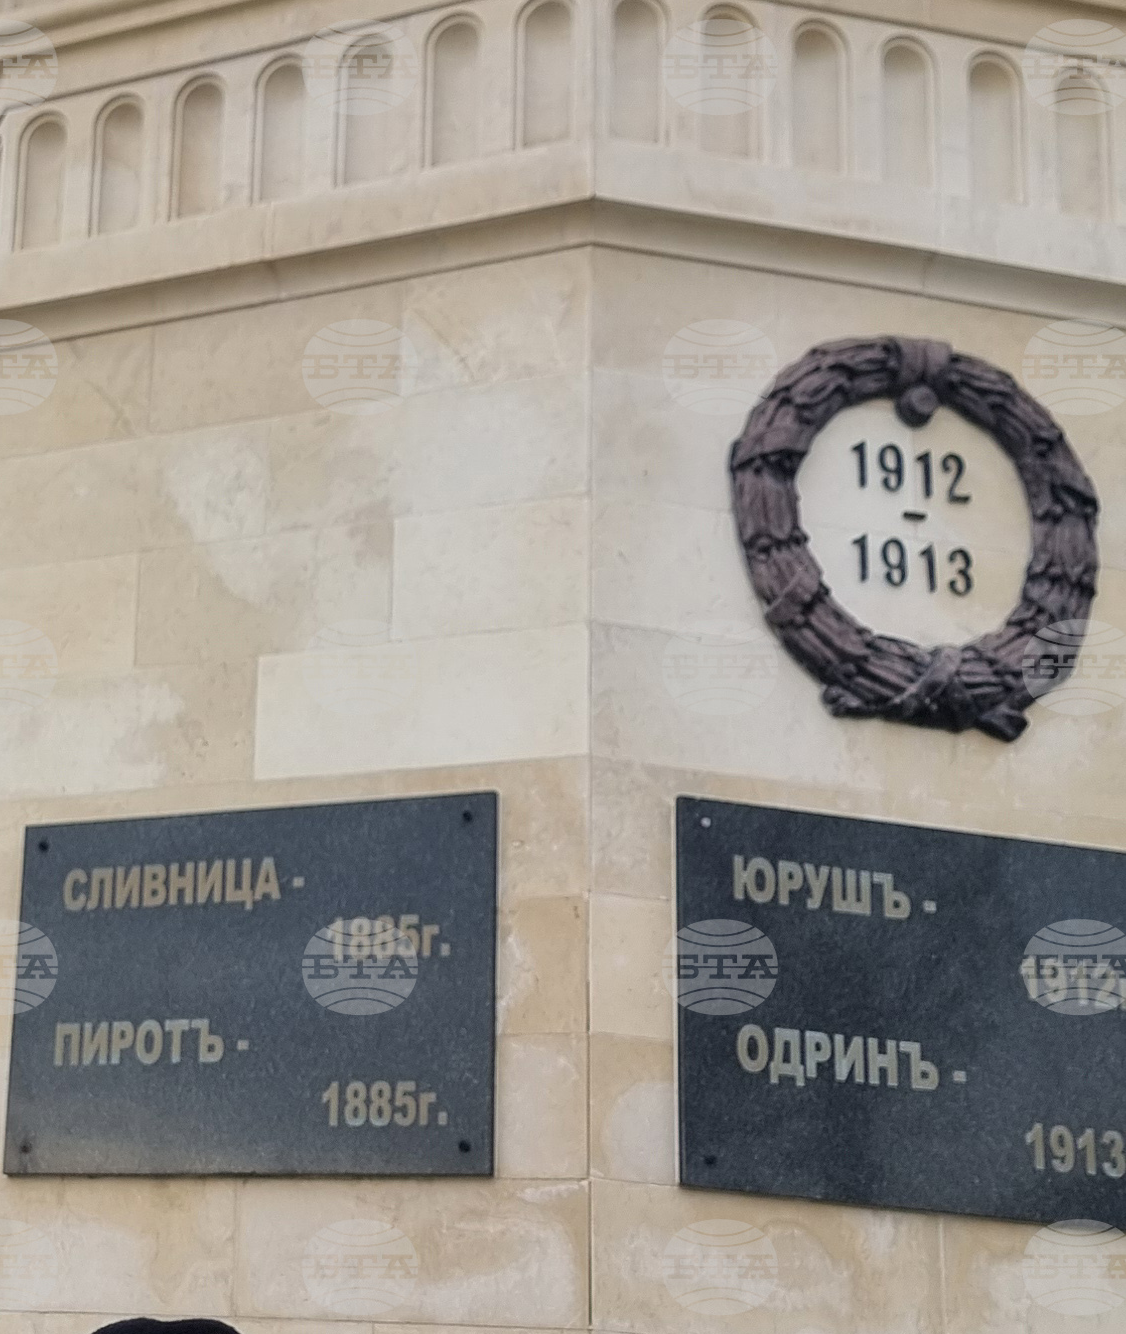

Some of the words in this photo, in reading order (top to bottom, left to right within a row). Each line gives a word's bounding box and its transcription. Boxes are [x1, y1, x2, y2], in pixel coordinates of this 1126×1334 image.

[851, 440, 972, 505] 1912
[851, 534, 973, 597] 1913
[62, 856, 281, 911] СЛИВНИЦА
[732, 854, 911, 919] ЮРУШЪ
[326, 914, 451, 960] 1885г.
[53, 1018, 225, 1067] ПИРОТЪ
[736, 1024, 939, 1091] ОДРИНЪ
[321, 1080, 449, 1127] 1885г.
[1024, 1122, 1126, 1178] 1913
